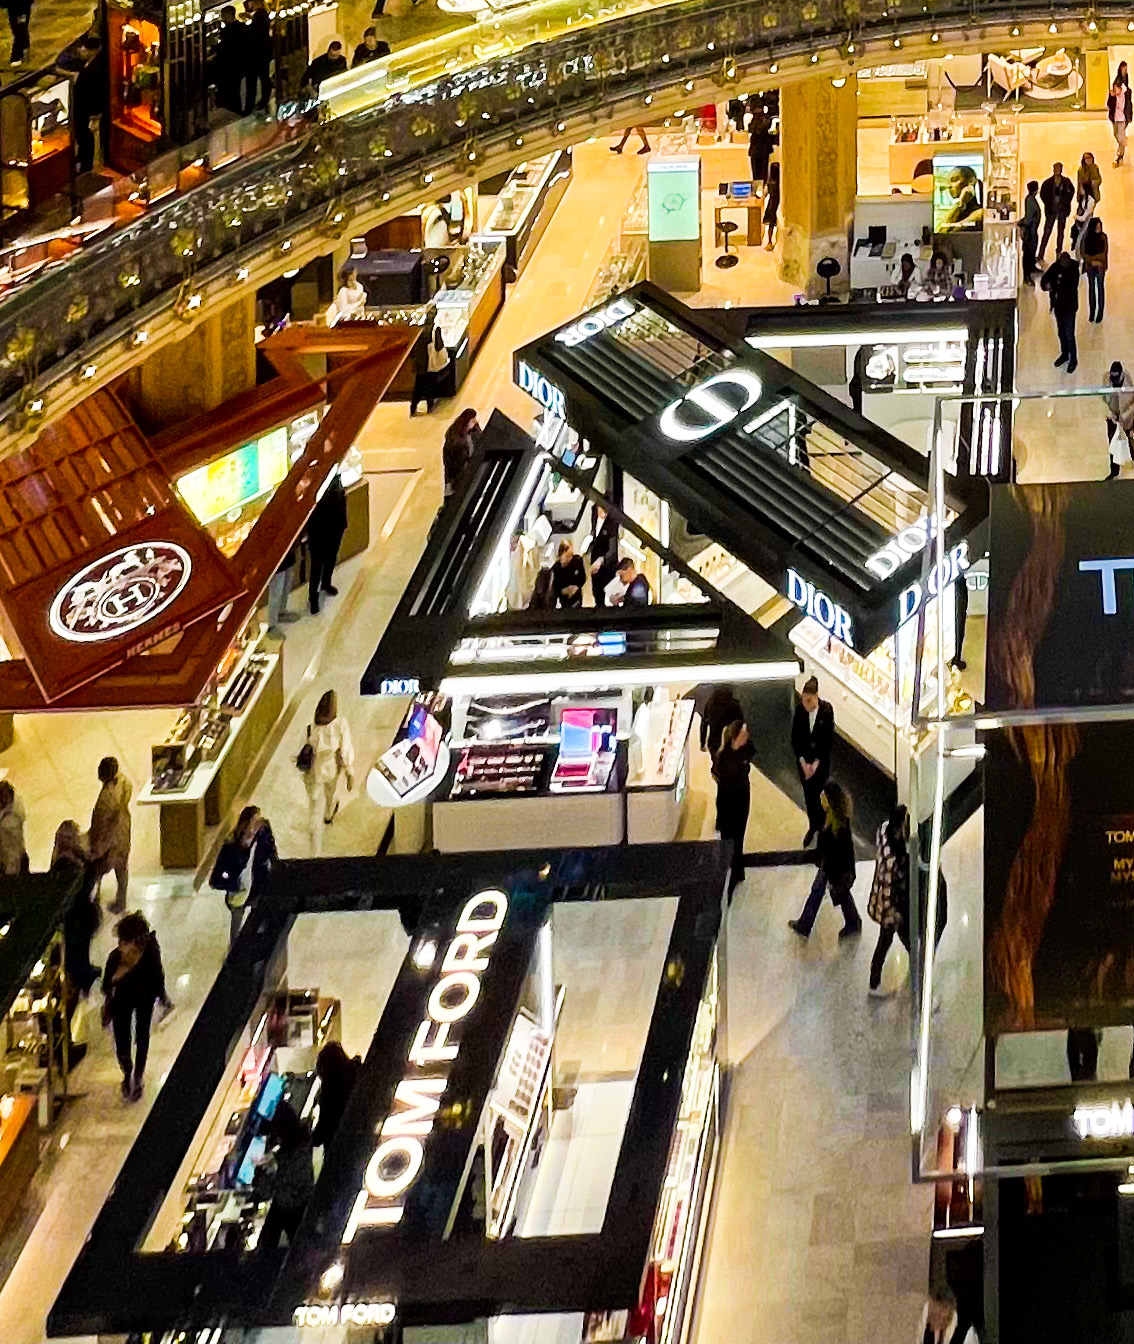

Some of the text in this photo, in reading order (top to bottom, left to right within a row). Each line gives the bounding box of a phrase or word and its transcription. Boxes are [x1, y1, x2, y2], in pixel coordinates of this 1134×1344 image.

[518, 360, 566, 420] DIOR
[786, 567, 854, 648] DIOR
[898, 540, 971, 627] DOR
[380, 678, 420, 695] DIOR
[340, 887, 511, 1246] TOM FORD
[1073, 1099, 1133, 1140] TOM
[293, 1301, 396, 1327] TOM FORD
